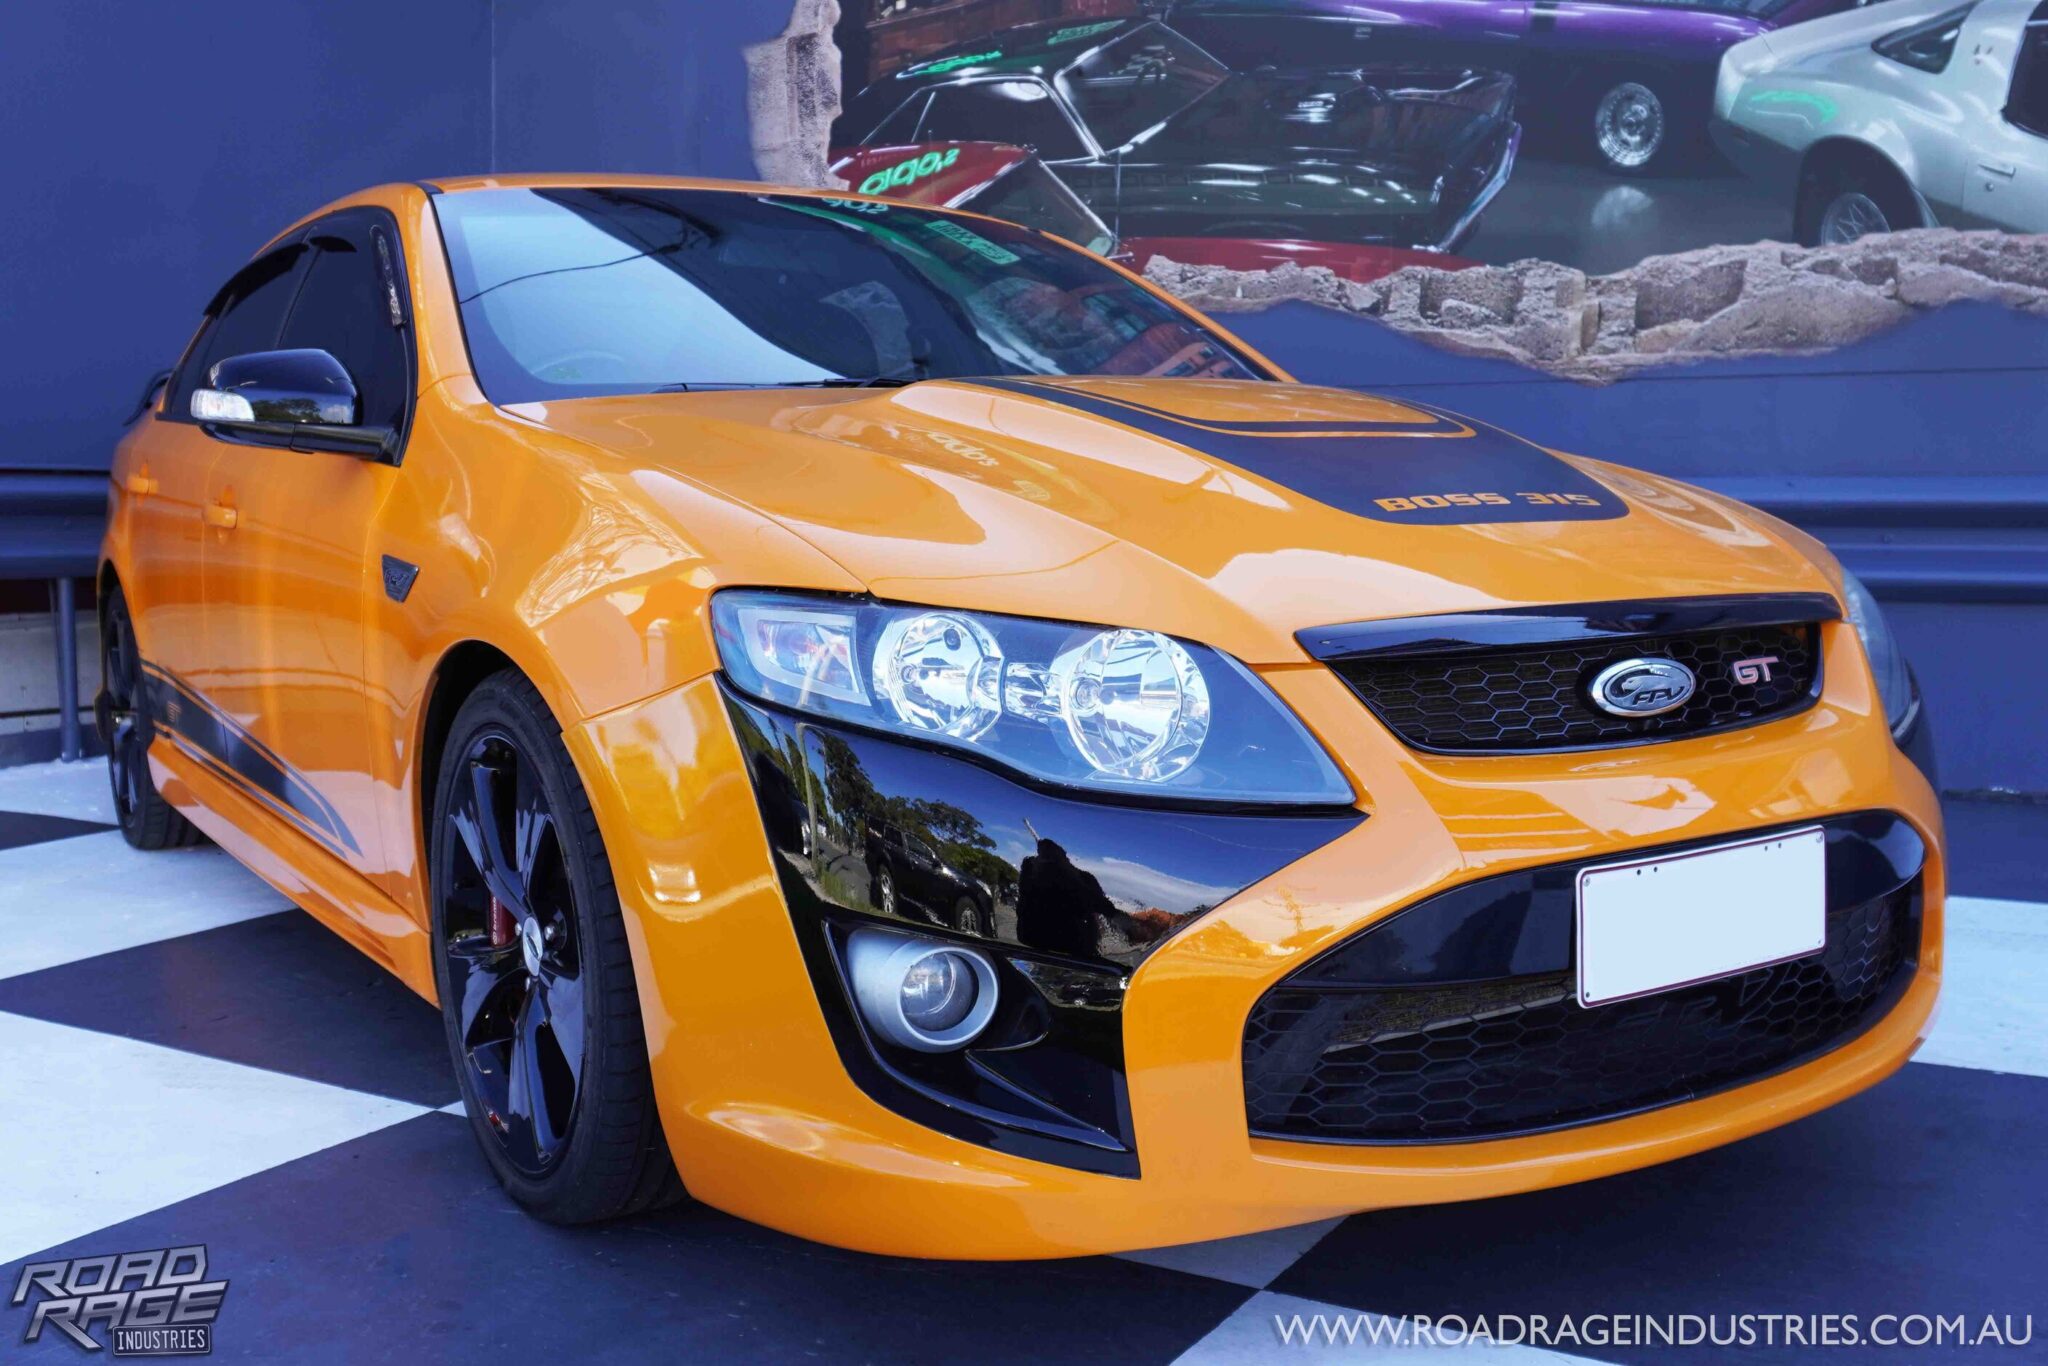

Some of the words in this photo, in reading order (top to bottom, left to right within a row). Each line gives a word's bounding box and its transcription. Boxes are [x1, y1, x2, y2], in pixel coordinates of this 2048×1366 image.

[1373, 492, 1511, 512] BOSS
[1516, 492, 1601, 506] 315
[1733, 656, 1779, 686] GT
